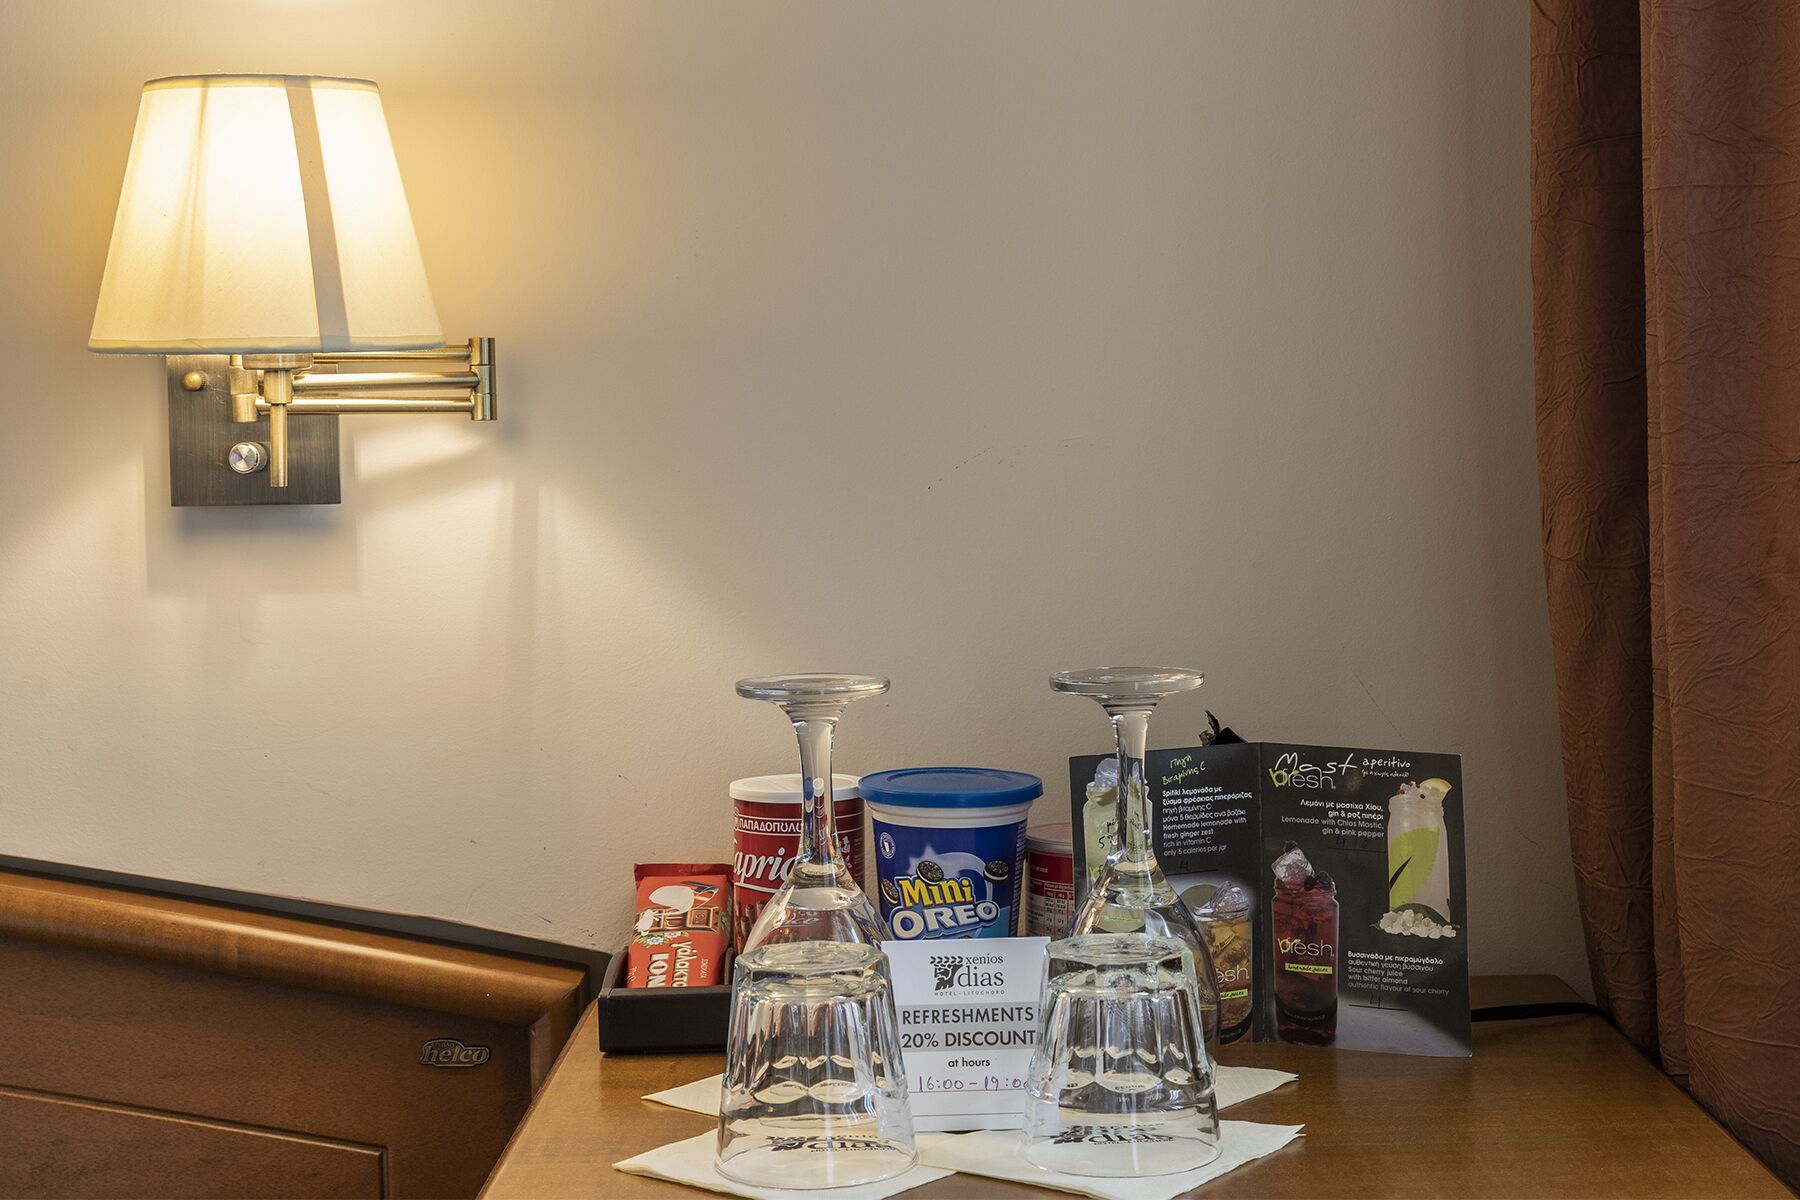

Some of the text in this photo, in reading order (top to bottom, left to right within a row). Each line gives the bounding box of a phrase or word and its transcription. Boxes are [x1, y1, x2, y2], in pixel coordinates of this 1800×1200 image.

[1362, 756, 1410, 769] aperitivo
[1182, 787, 1214, 796] λεμονάδα
[1336, 802, 1363, 810] μαστίχα
[1328, 810, 1339, 818] gin
[1347, 811, 1360, 819] ροζ
[1163, 822, 1200, 830] Homemade
[1201, 819, 1232, 827] lemonade
[1282, 816, 1319, 824] Lemonade
[1321, 818, 1335, 826] with
[1180, 830, 1200, 839] ginger
[1358, 830, 1384, 838] pepper
[1183, 838, 1205, 846] vitamin
[1183, 846, 1206, 854] calories
[900, 880, 973, 908] Mini
[893, 902, 998, 939] OREO
[966, 953, 1004, 964] xenios
[958, 965, 1004, 987] dias
[1364, 968, 1385, 976] cherry
[1348, 982, 1379, 990] authentic
[1428, 988, 1449, 996] cherry
[903, 1007, 1033, 1024] REFRESHMENTS
[901, 1030, 1036, 1048] 20% DISCOUNT
[422, 1045, 487, 1062] helco
[948, 1057, 990, 1068] at hours
[919, 1076, 963, 1092] 16:00
